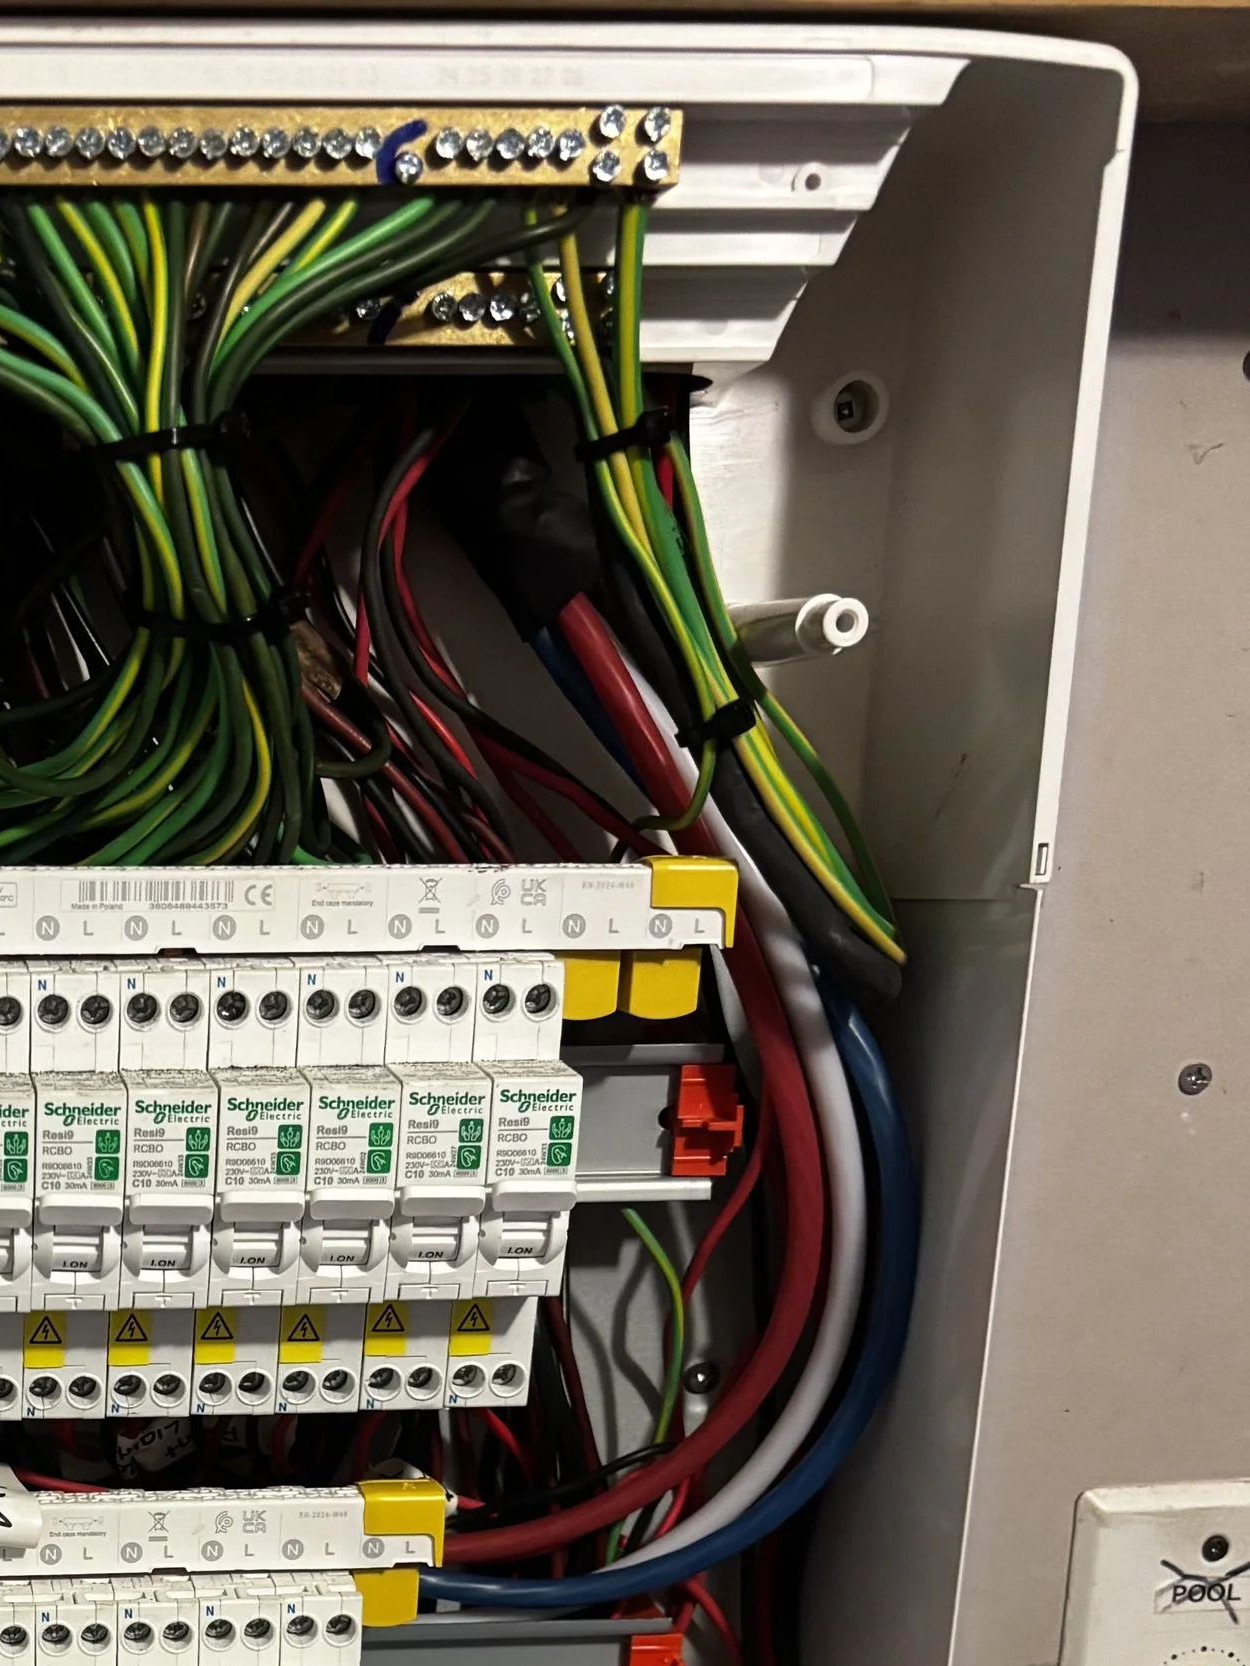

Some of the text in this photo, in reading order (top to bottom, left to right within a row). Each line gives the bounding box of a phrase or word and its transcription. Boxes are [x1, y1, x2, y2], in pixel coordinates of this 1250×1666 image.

[409, 1092, 485, 1112] Schneider
[500, 1088, 576, 1109] Schneider
[135, 1100, 212, 1120] Schneider
[227, 1098, 304, 1117] Schneider
[318, 1096, 394, 1116] Schneider
[442, 1106, 483, 1114] Electric
[532, 1102, 574, 1112] Electric
[44, 1102, 121, 1122] Schneider
[260, 1112, 302, 1120] Electric
[352, 1110, 393, 1118] Electric
[77, 1116, 120, 1126] Electric
[167, 1114, 210, 1123] Electric
[498, 1117, 530, 1126] Resi9
[408, 1120, 439, 1129] Resi9
[134, 1128, 165, 1137] Resi9
[227, 1126, 258, 1135] Resi9
[316, 1125, 348, 1135] Resi9
[42, 1130, 74, 1140] Resi9
[498, 1134, 527, 1142] RCBO
[407, 1136, 437, 1144] RCBO
[134, 1144, 163, 1153] RCBO
[226, 1143, 256, 1151] RCBO
[316, 1142, 346, 1150] RCBO
[42, 1147, 72, 1156] RCBO
[405, 1170, 424, 1179] C10
[496, 1168, 514, 1176] C10
[42, 1181, 60, 1190] C10
[132, 1179, 151, 1188] C10
[225, 1177, 244, 1185] C10
[314, 1177, 333, 1185] C10
[1172, 1583, 1241, 1602] POOL
